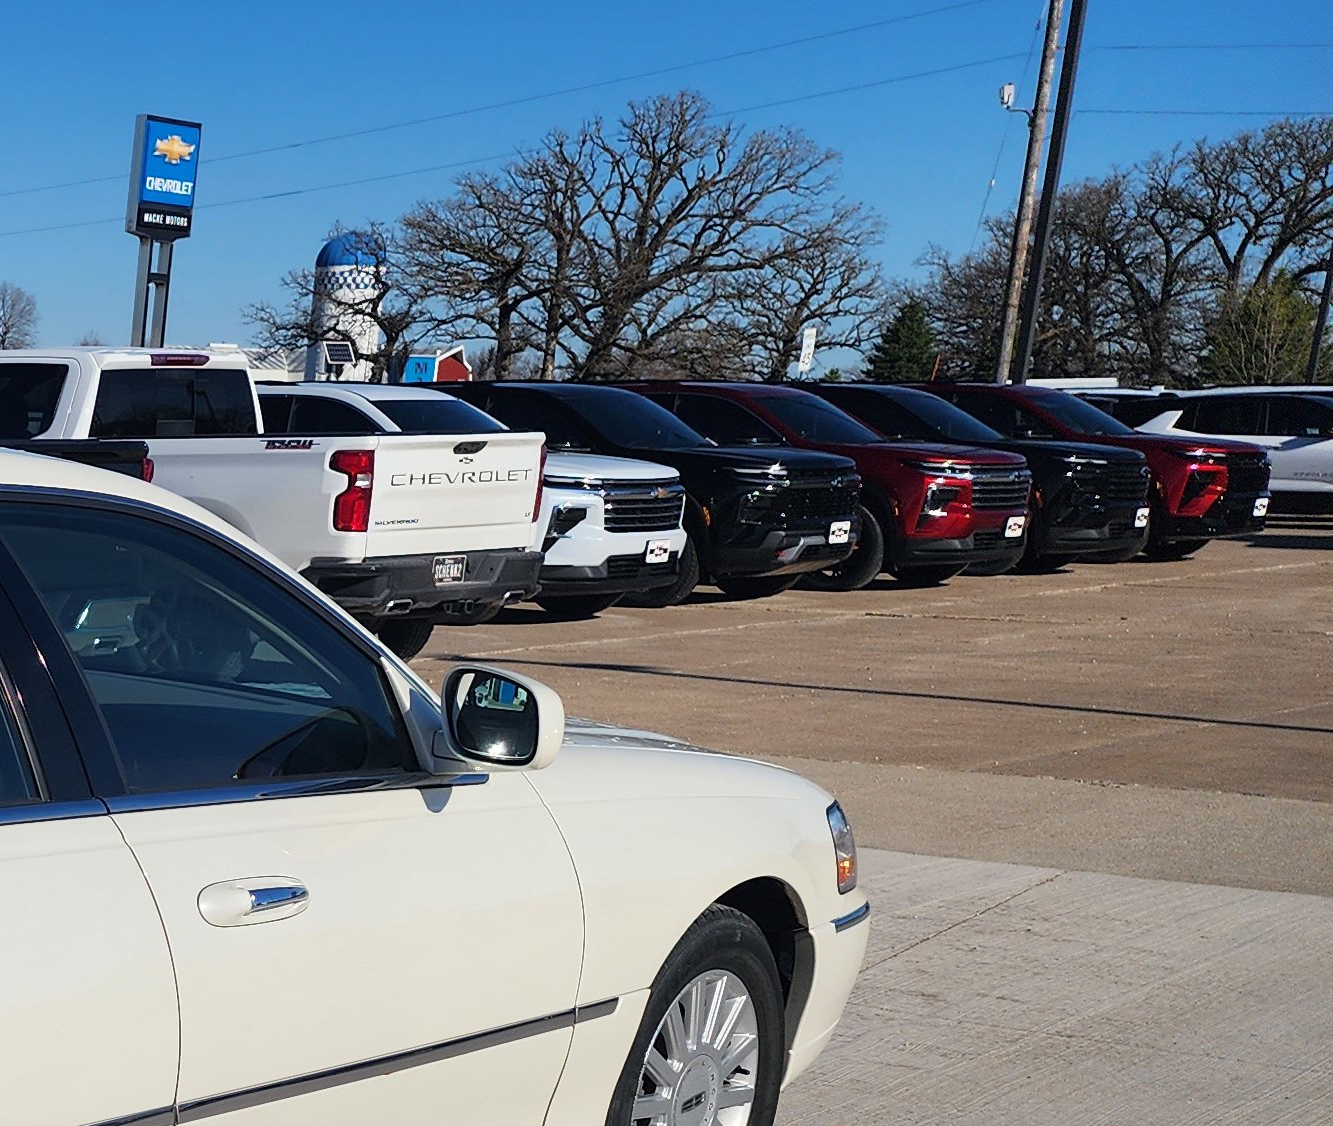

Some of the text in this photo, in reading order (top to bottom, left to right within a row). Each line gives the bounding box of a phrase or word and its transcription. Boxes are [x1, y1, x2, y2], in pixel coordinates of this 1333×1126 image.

[145, 176, 194, 196] CHEVROLET
[143, 212, 189, 227] MACKE MOTORS
[390, 468, 533, 487] CHEVROLET
